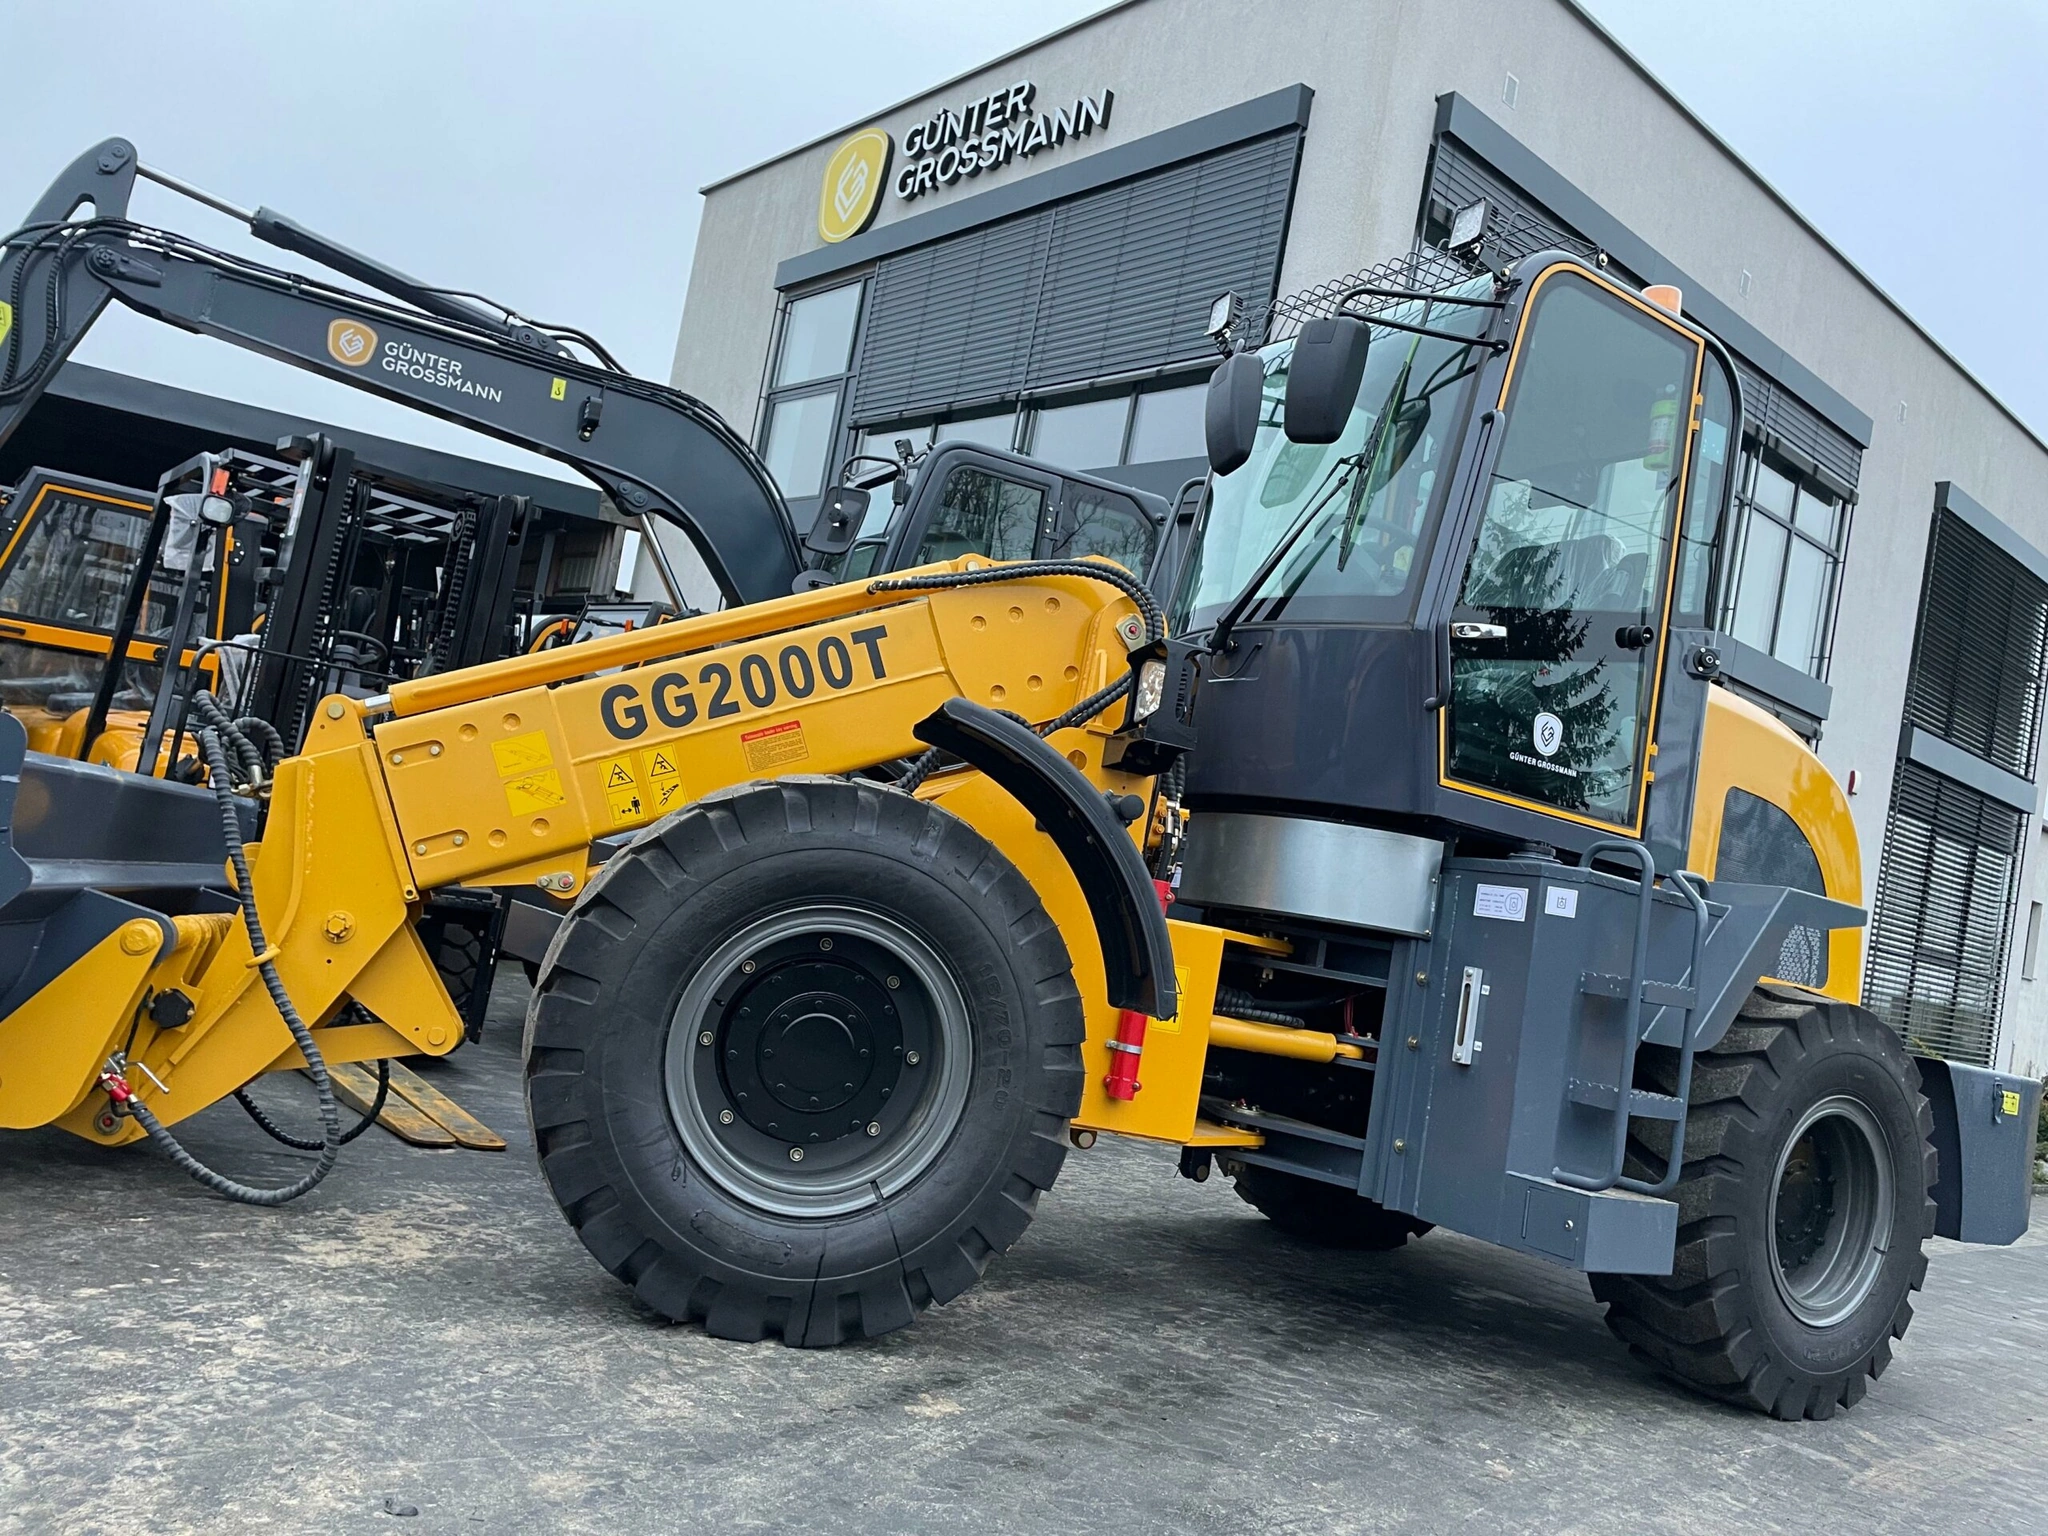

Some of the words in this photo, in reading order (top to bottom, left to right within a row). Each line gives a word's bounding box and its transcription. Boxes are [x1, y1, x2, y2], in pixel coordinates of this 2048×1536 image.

[894, 87, 1113, 199] GROSSMANN
[901, 79, 1035, 158] GÜNTER
[382, 357, 502, 403] GROSSMANN
[384, 341, 462, 376] GÜNTER
[600, 624, 888, 740] GG2000T
[1509, 751, 1536, 766] GÜNTER
[1537, 760, 1577, 777] GROSSMANN
